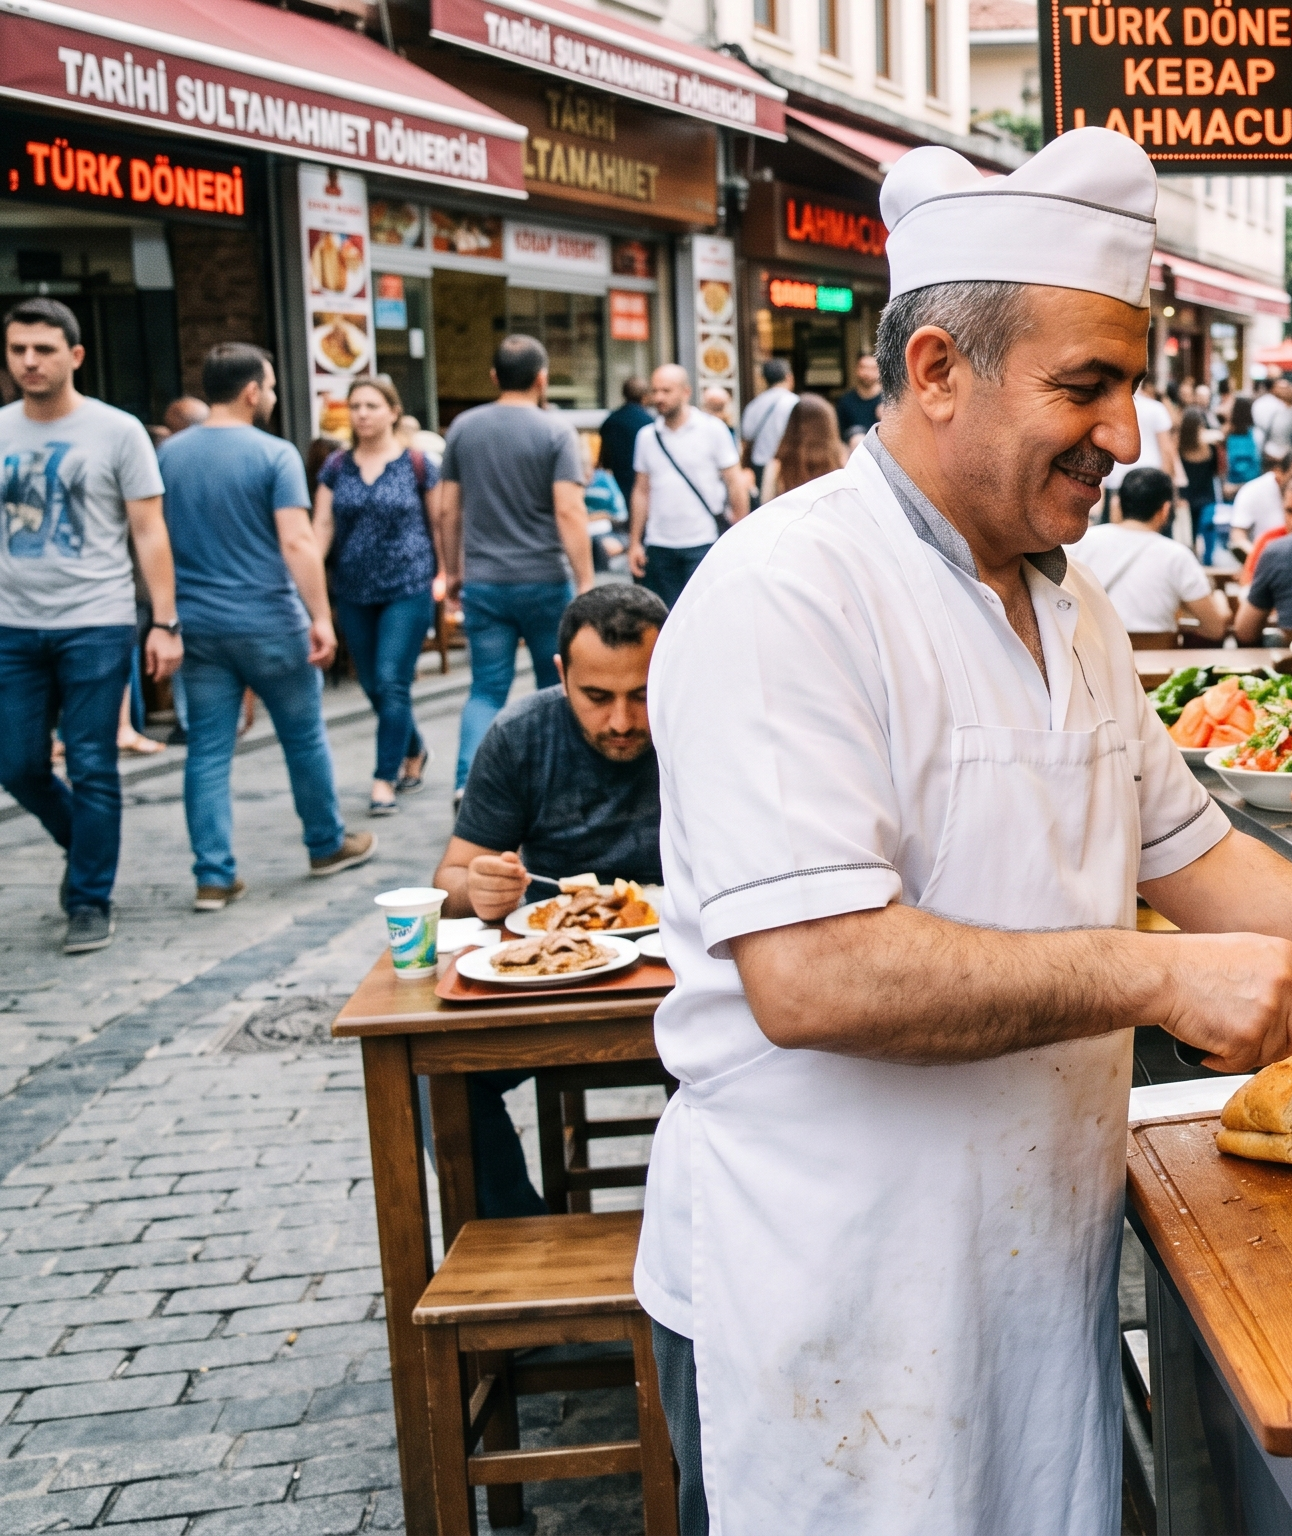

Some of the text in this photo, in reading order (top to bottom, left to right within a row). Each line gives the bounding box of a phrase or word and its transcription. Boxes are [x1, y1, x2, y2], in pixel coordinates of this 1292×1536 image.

[1062, 0, 1172, 46] TÜRK
[1124, 57, 1276, 96] KEBAP
[58, 46, 489, 181] TARİHİ SULTANAHMET DÖNERCİSİ
[26, 137, 124, 198] TÜRK
[130, 154, 245, 216] DÖNERİ
